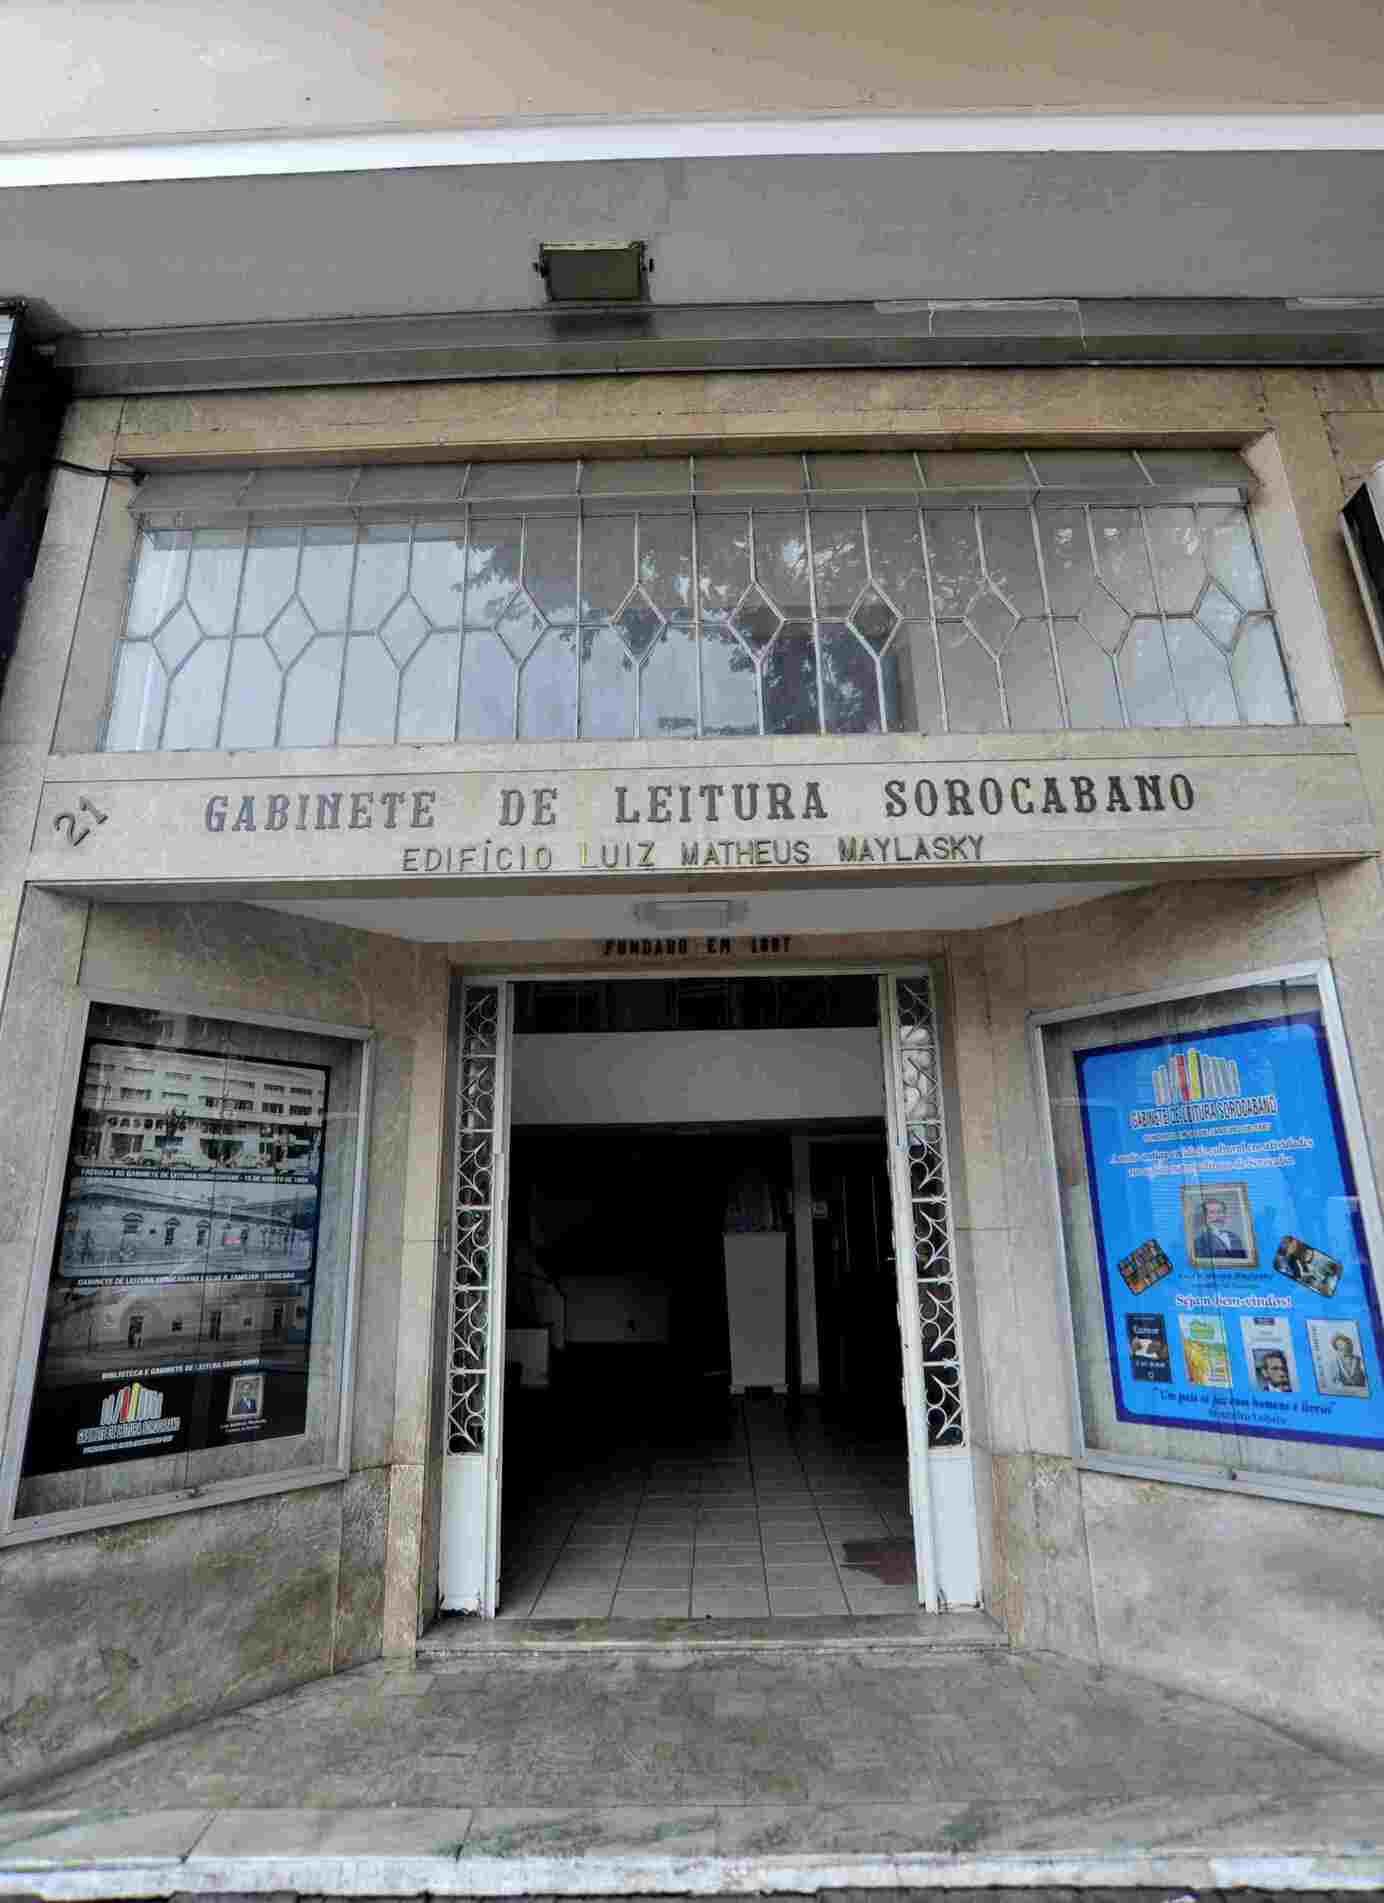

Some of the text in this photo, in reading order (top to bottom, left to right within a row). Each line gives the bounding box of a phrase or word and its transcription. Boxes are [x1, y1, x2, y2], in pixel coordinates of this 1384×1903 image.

[54, 796, 108, 847] 21
[204, 773, 1197, 833] GABINETE DE LEITURA SOROCABANO
[402, 836, 985, 873] EDIFÍCIO LUIZ MATHEUS MAYLASKY
[603, 938, 688, 957] FUNDADO
[706, 937, 732, 954] EM
